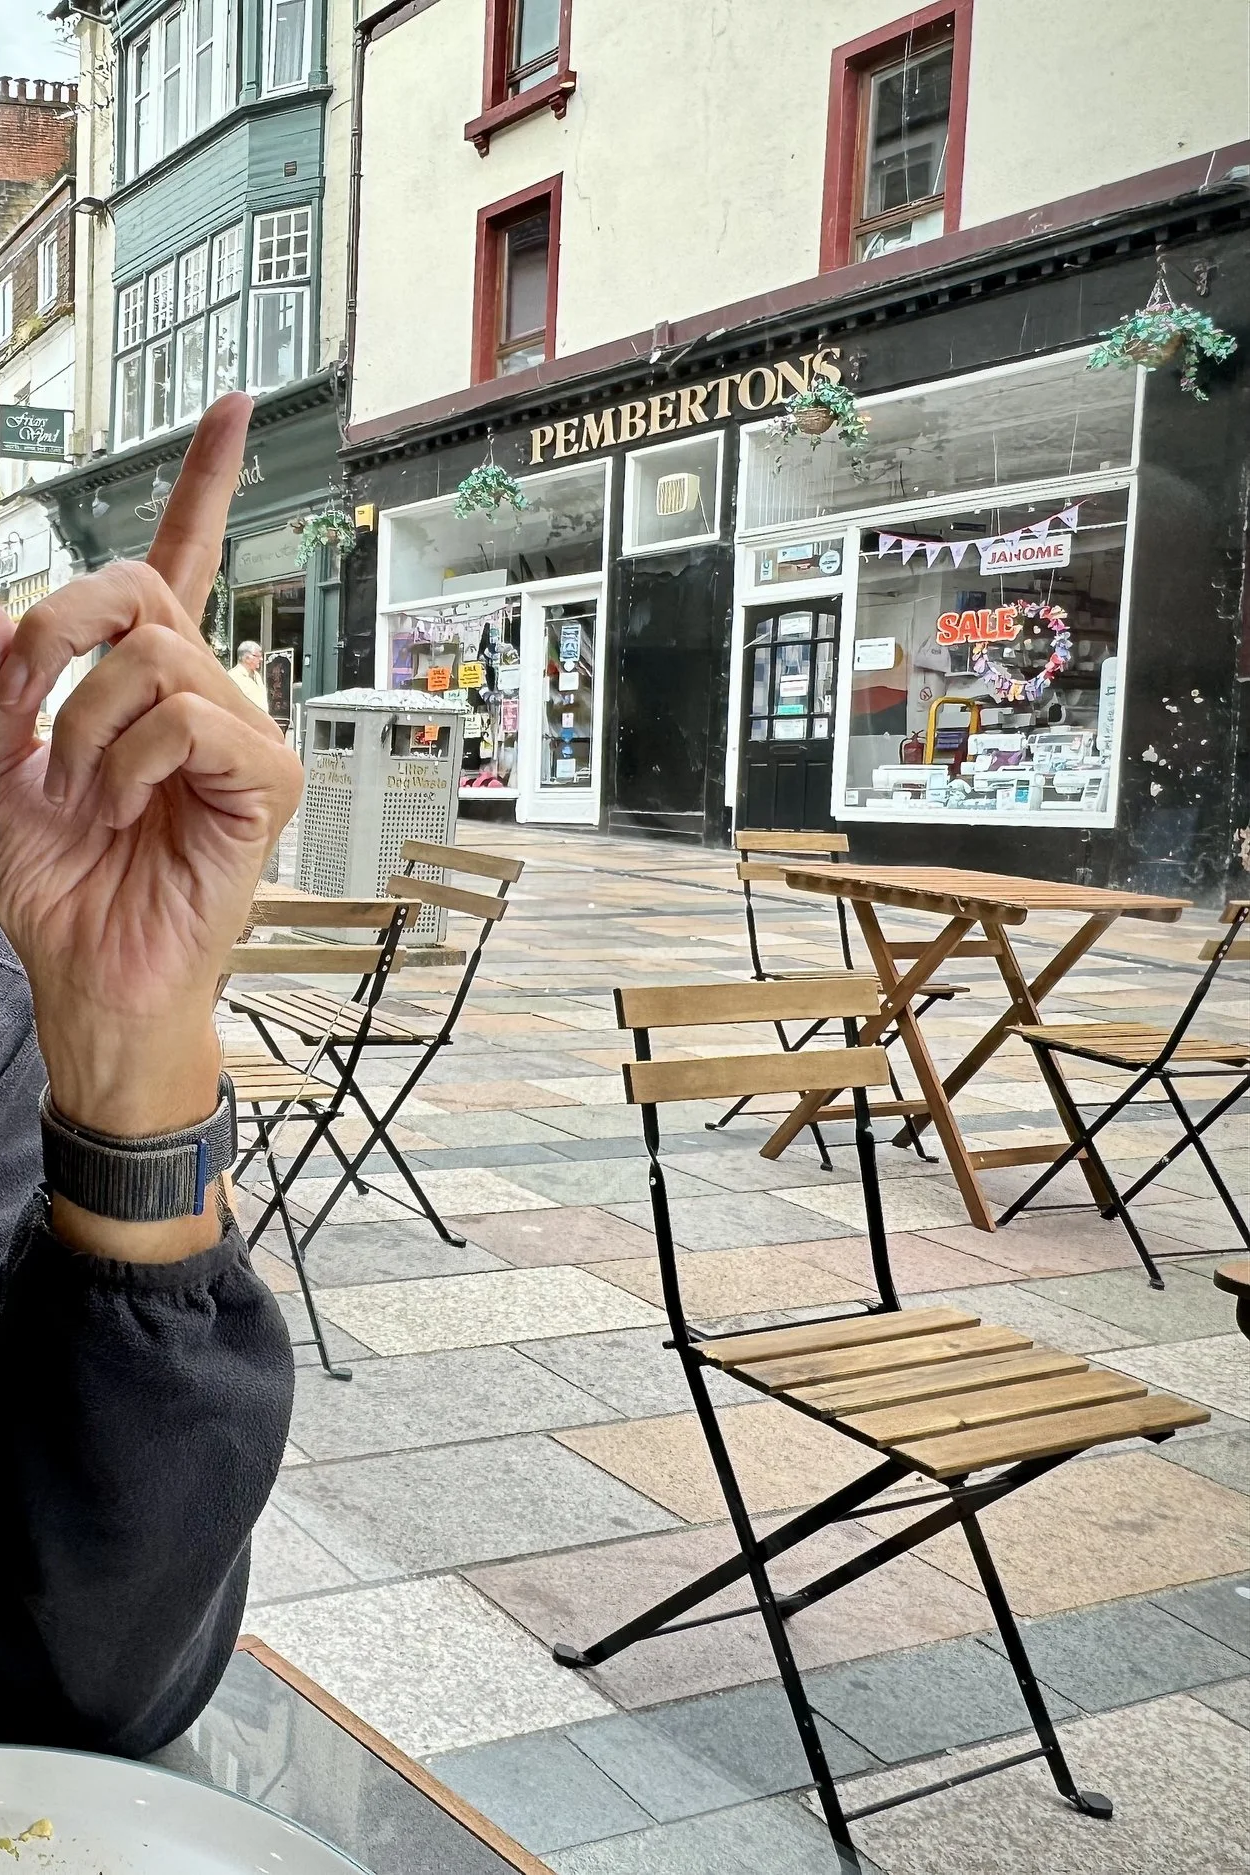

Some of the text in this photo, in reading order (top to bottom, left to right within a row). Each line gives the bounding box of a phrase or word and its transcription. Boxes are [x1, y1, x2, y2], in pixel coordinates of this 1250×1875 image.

[530, 347, 842, 466] PEMBERTONS
[988, 544, 1064, 565] JANOME
[936, 607, 1019, 645] SALE
